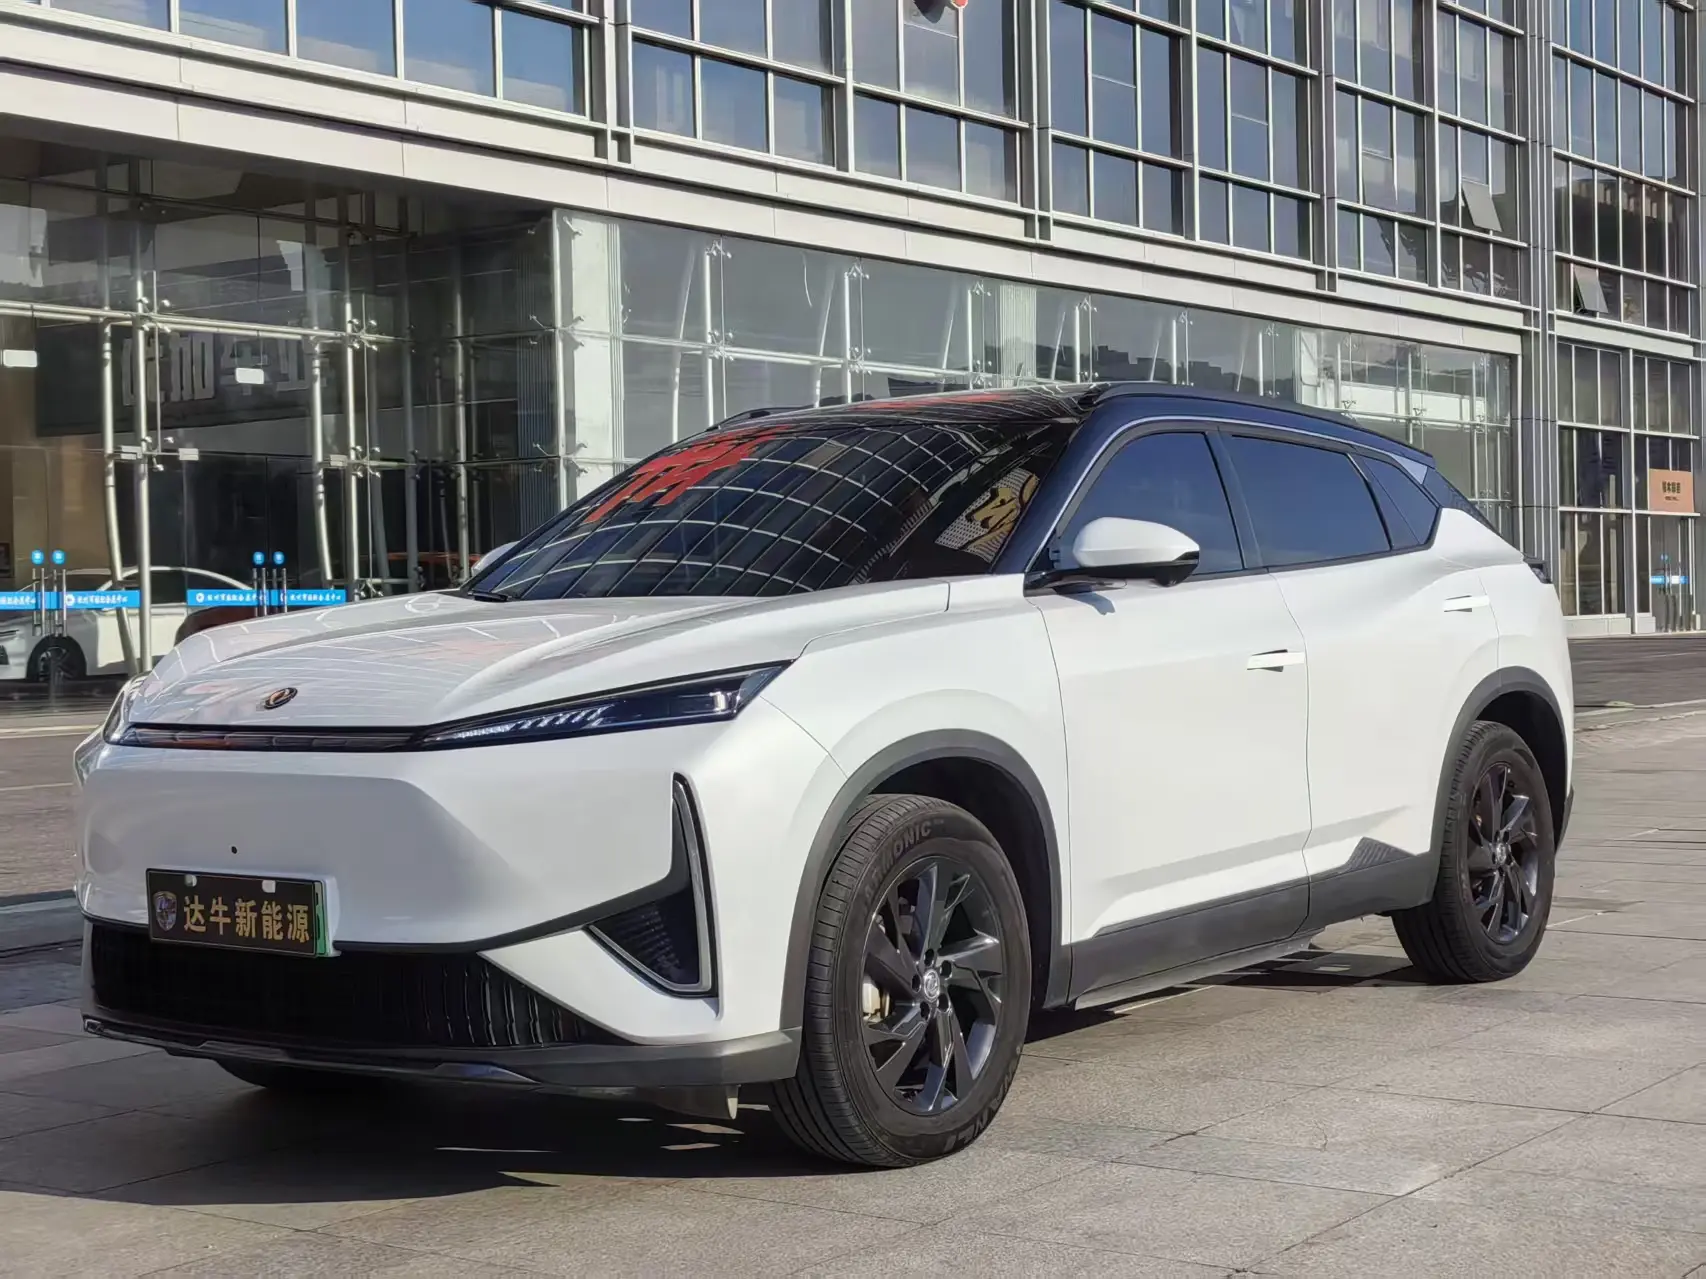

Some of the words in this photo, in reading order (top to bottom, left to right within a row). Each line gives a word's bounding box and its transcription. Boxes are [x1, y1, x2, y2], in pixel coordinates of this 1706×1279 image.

[183, 894, 310, 943] 达牛新能源
